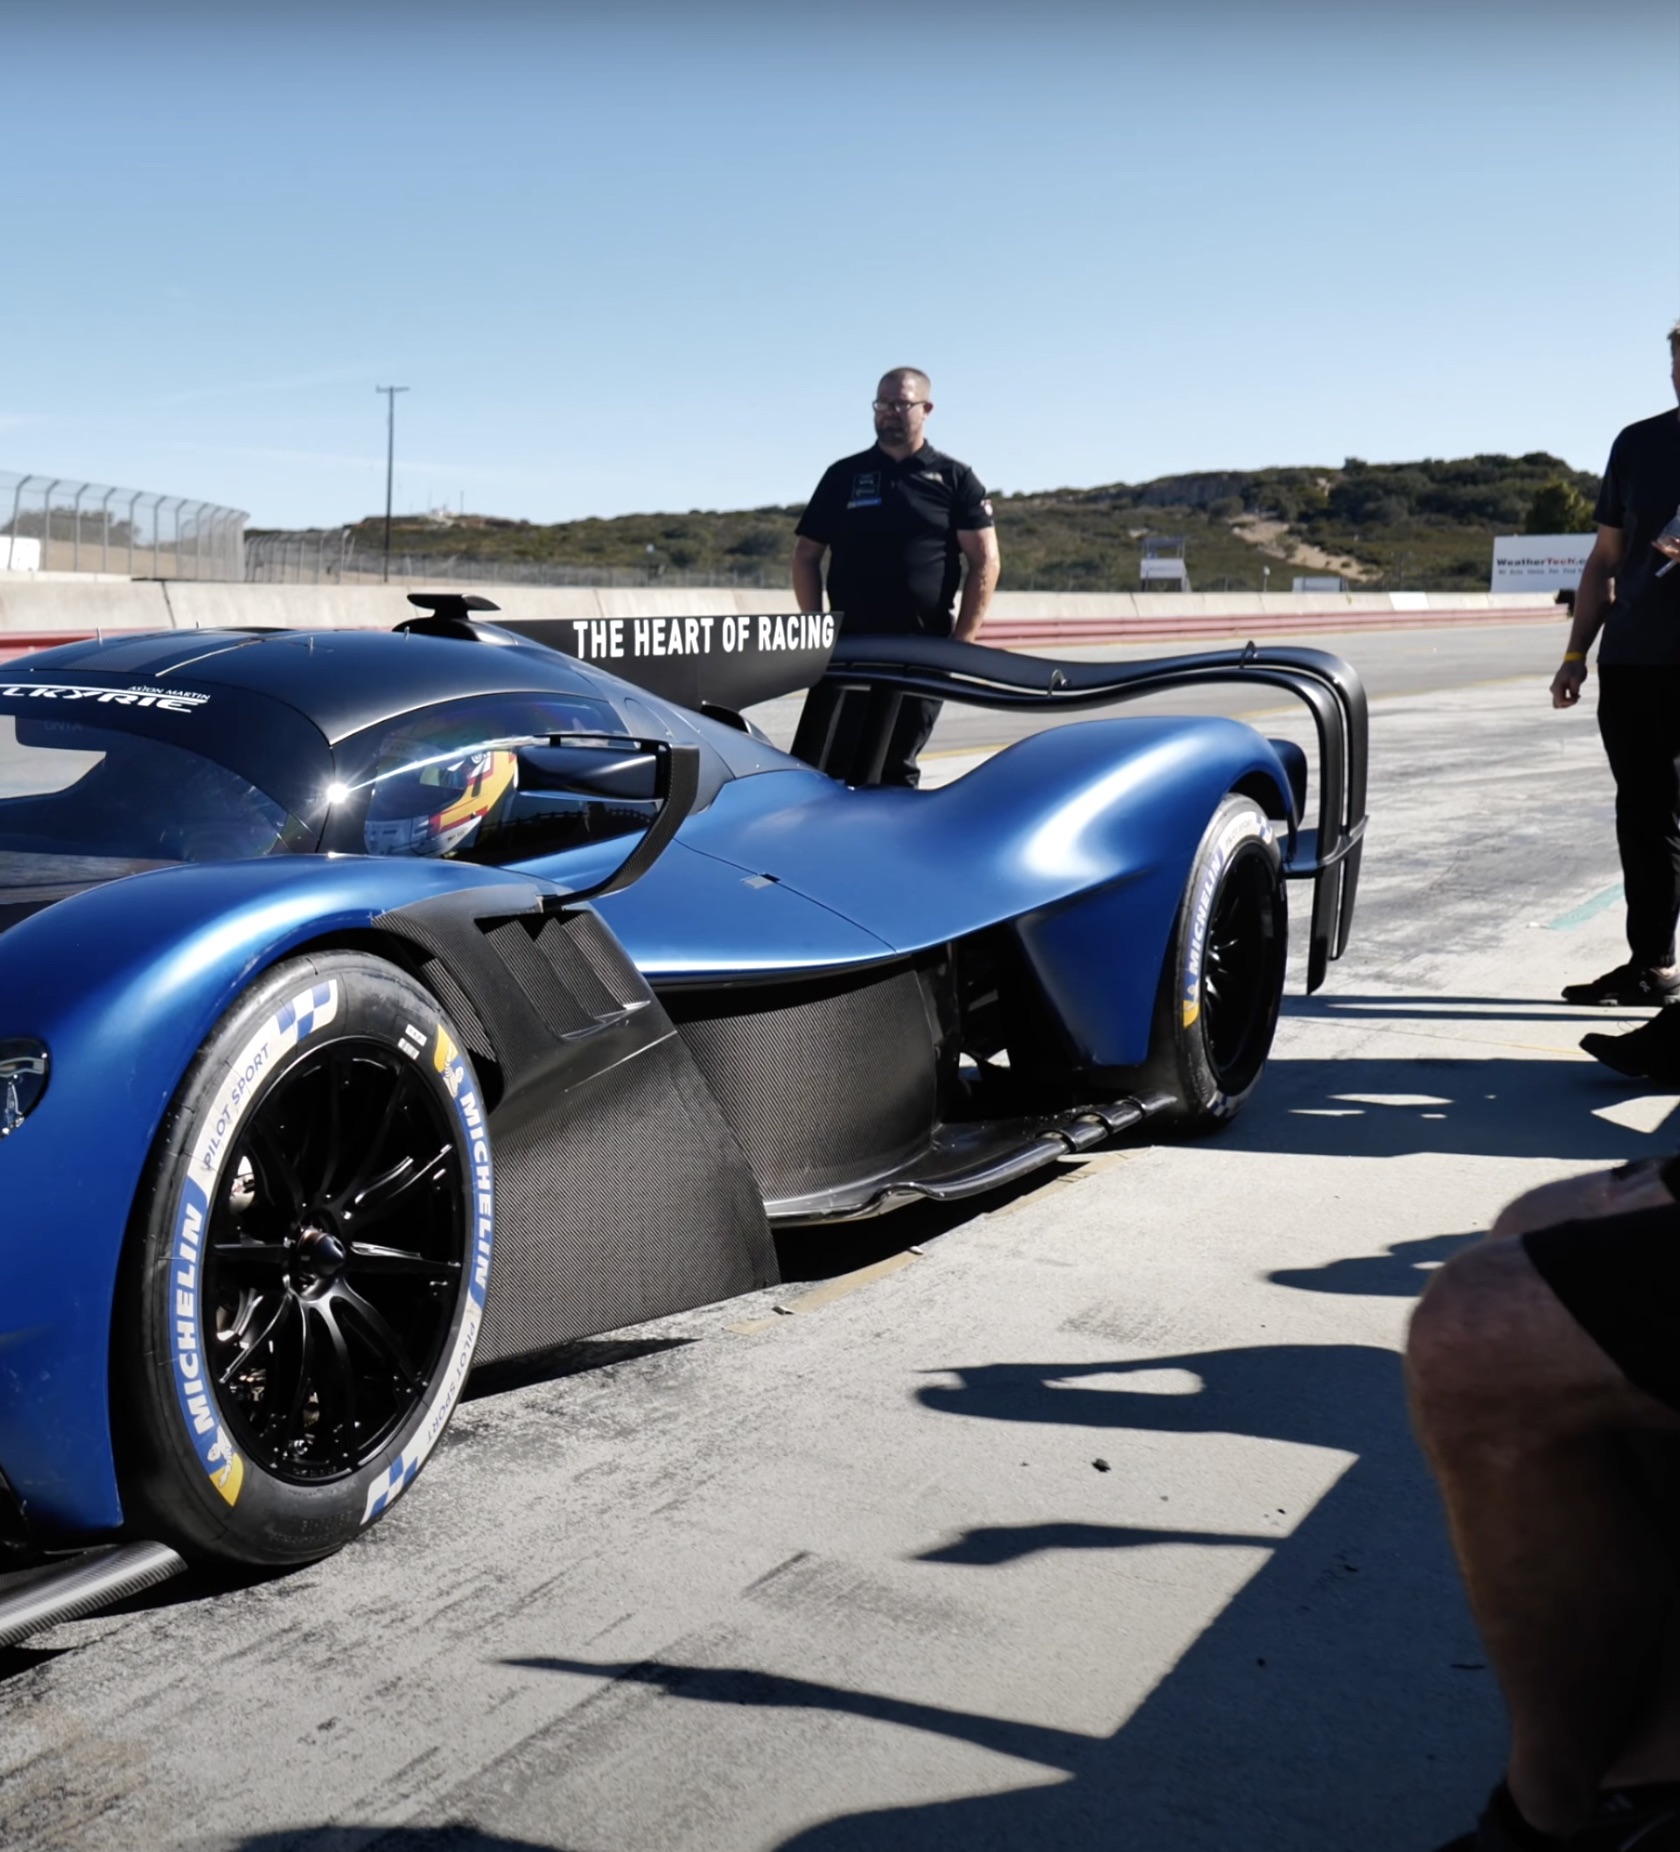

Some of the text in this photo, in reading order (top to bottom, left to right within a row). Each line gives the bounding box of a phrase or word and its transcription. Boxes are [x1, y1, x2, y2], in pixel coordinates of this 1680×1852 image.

[127, 684, 211, 700] ASTON MARTIN
[573, 614, 835, 659] THE HEART OF RACING
[1187, 854, 1222, 975] MICHELIN
[204, 1042, 270, 1169] PILOT SPORT
[459, 1091, 494, 1295] MICHELIN
[175, 1203, 215, 1436] MICHELIN
[427, 1321, 476, 1446] PILOT SPORT
